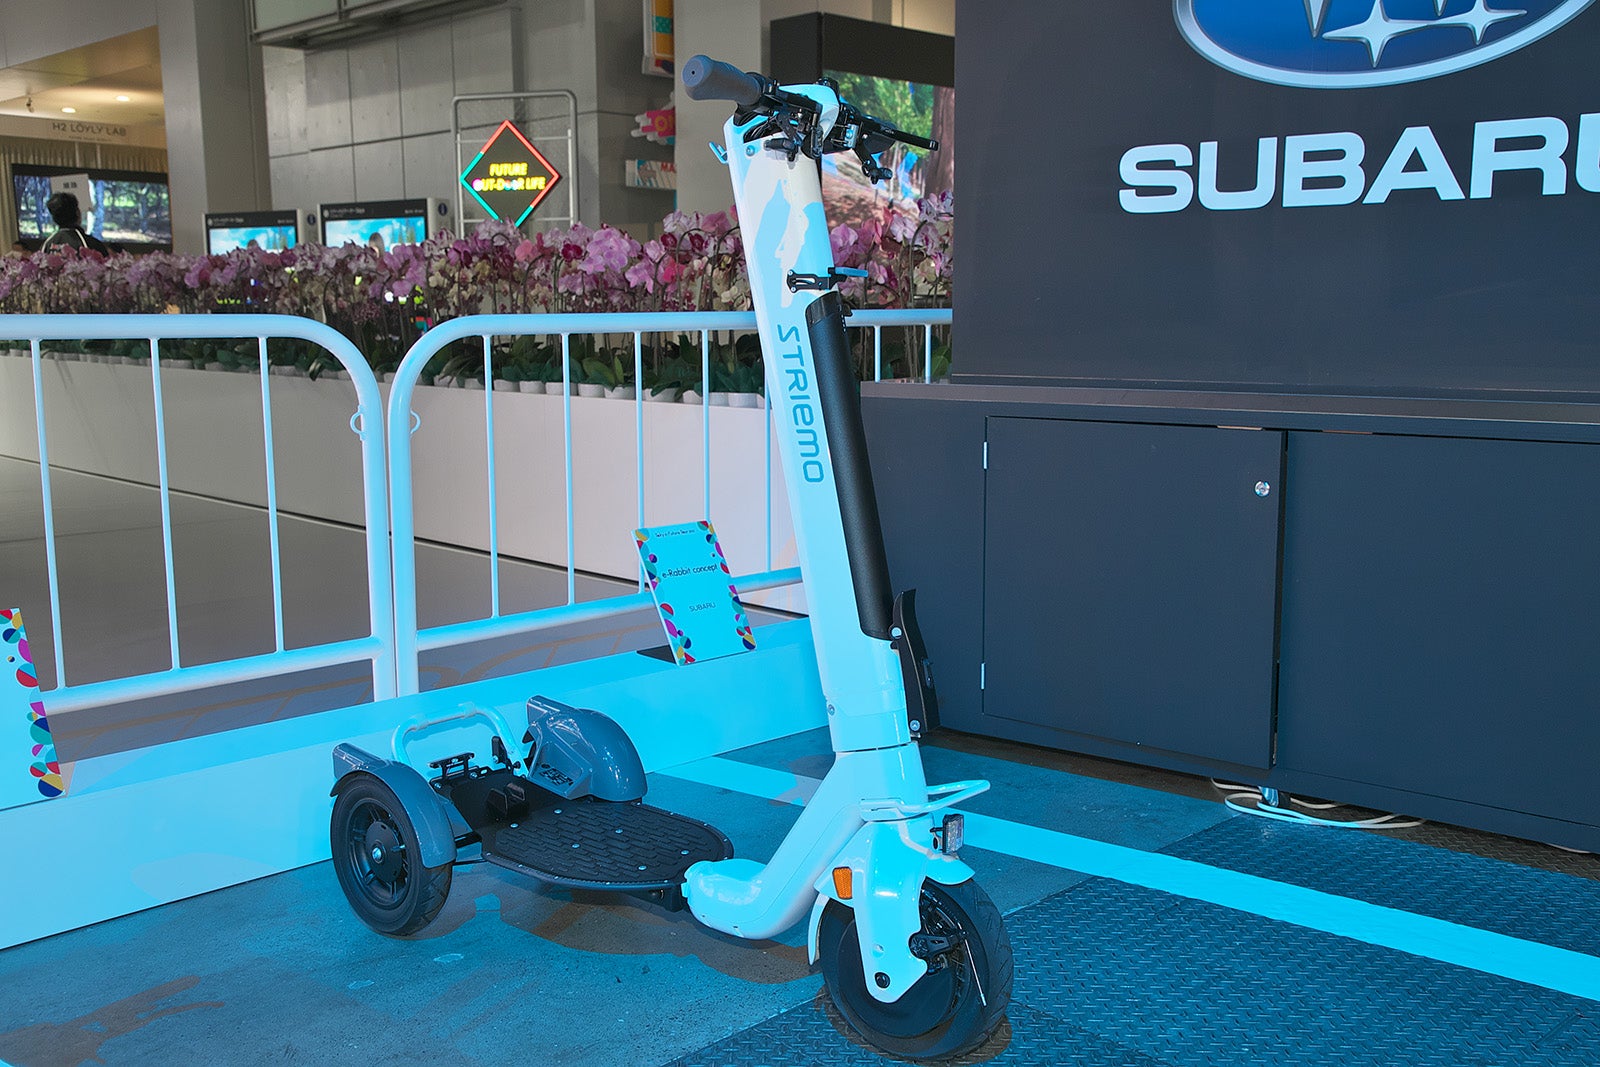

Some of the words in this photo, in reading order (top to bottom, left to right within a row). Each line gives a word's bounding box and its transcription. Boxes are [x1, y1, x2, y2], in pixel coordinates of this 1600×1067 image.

[489, 162, 528, 176] FUTURE
[525, 176, 546, 190] LIFE
[662, 568, 691, 578] e-Rabbit
[692, 564, 718, 573] concept
[689, 603, 716, 612] SUBARU
